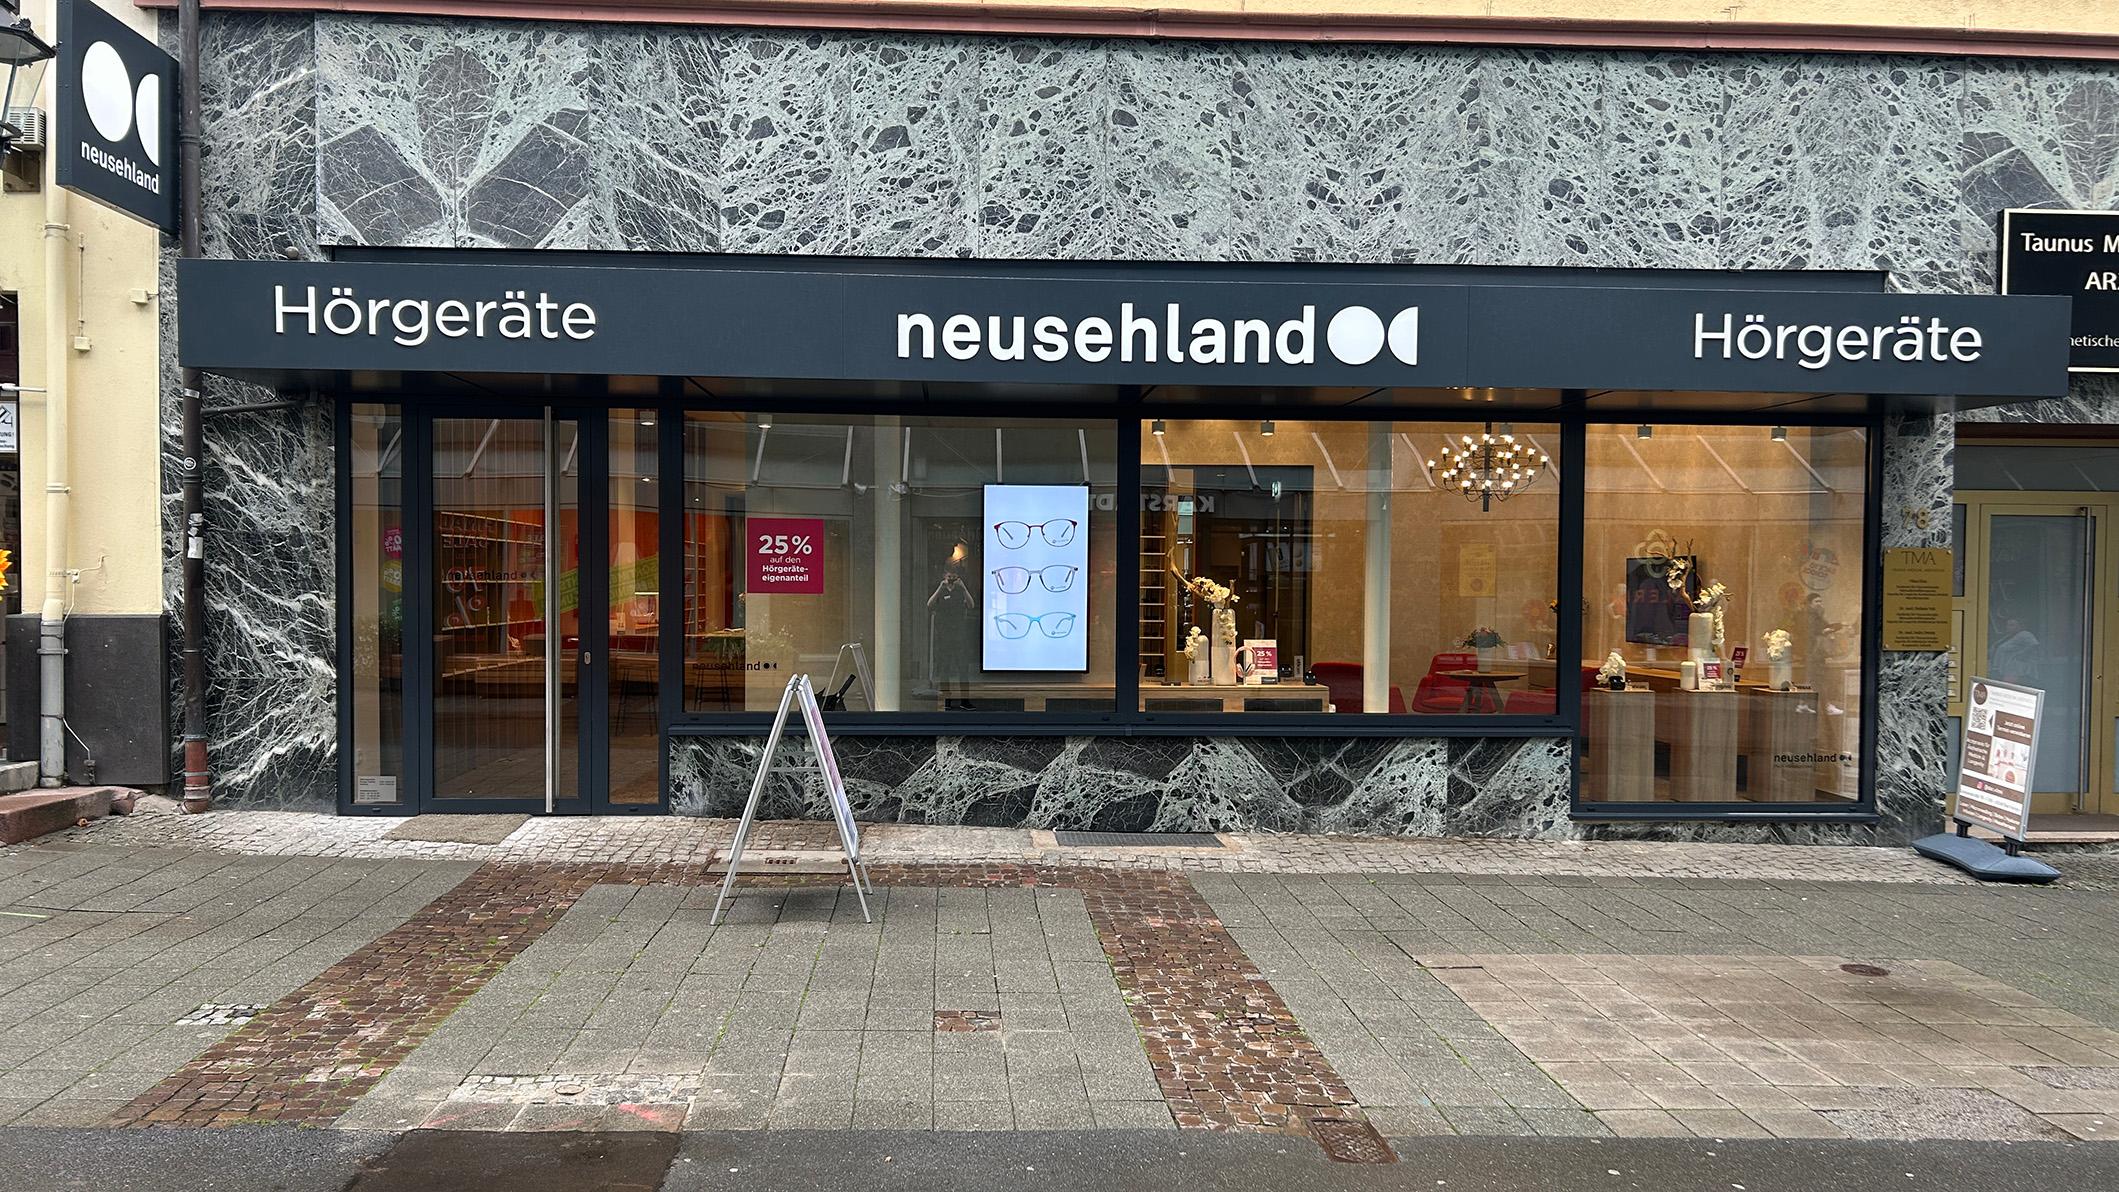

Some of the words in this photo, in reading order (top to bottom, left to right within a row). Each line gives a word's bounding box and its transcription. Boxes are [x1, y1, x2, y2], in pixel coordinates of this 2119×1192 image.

[81, 141, 160, 195] neusehland
[2020, 232, 2094, 253] Taunus
[2084, 271, 2119, 291] AR
[274, 285, 596, 346] Hörgeräte
[897, 302, 1316, 365] neusehland
[1694, 312, 1982, 369] Hörgeräte
[769, 556, 783, 564] auf
[784, 556, 801, 564] den
[1900, 551, 1936, 566] TMA
[761, 575, 809, 583] eigenanteil
[762, 565, 809, 574] Hörgeräte-
[1774, 753, 1837, 763] neusehland
